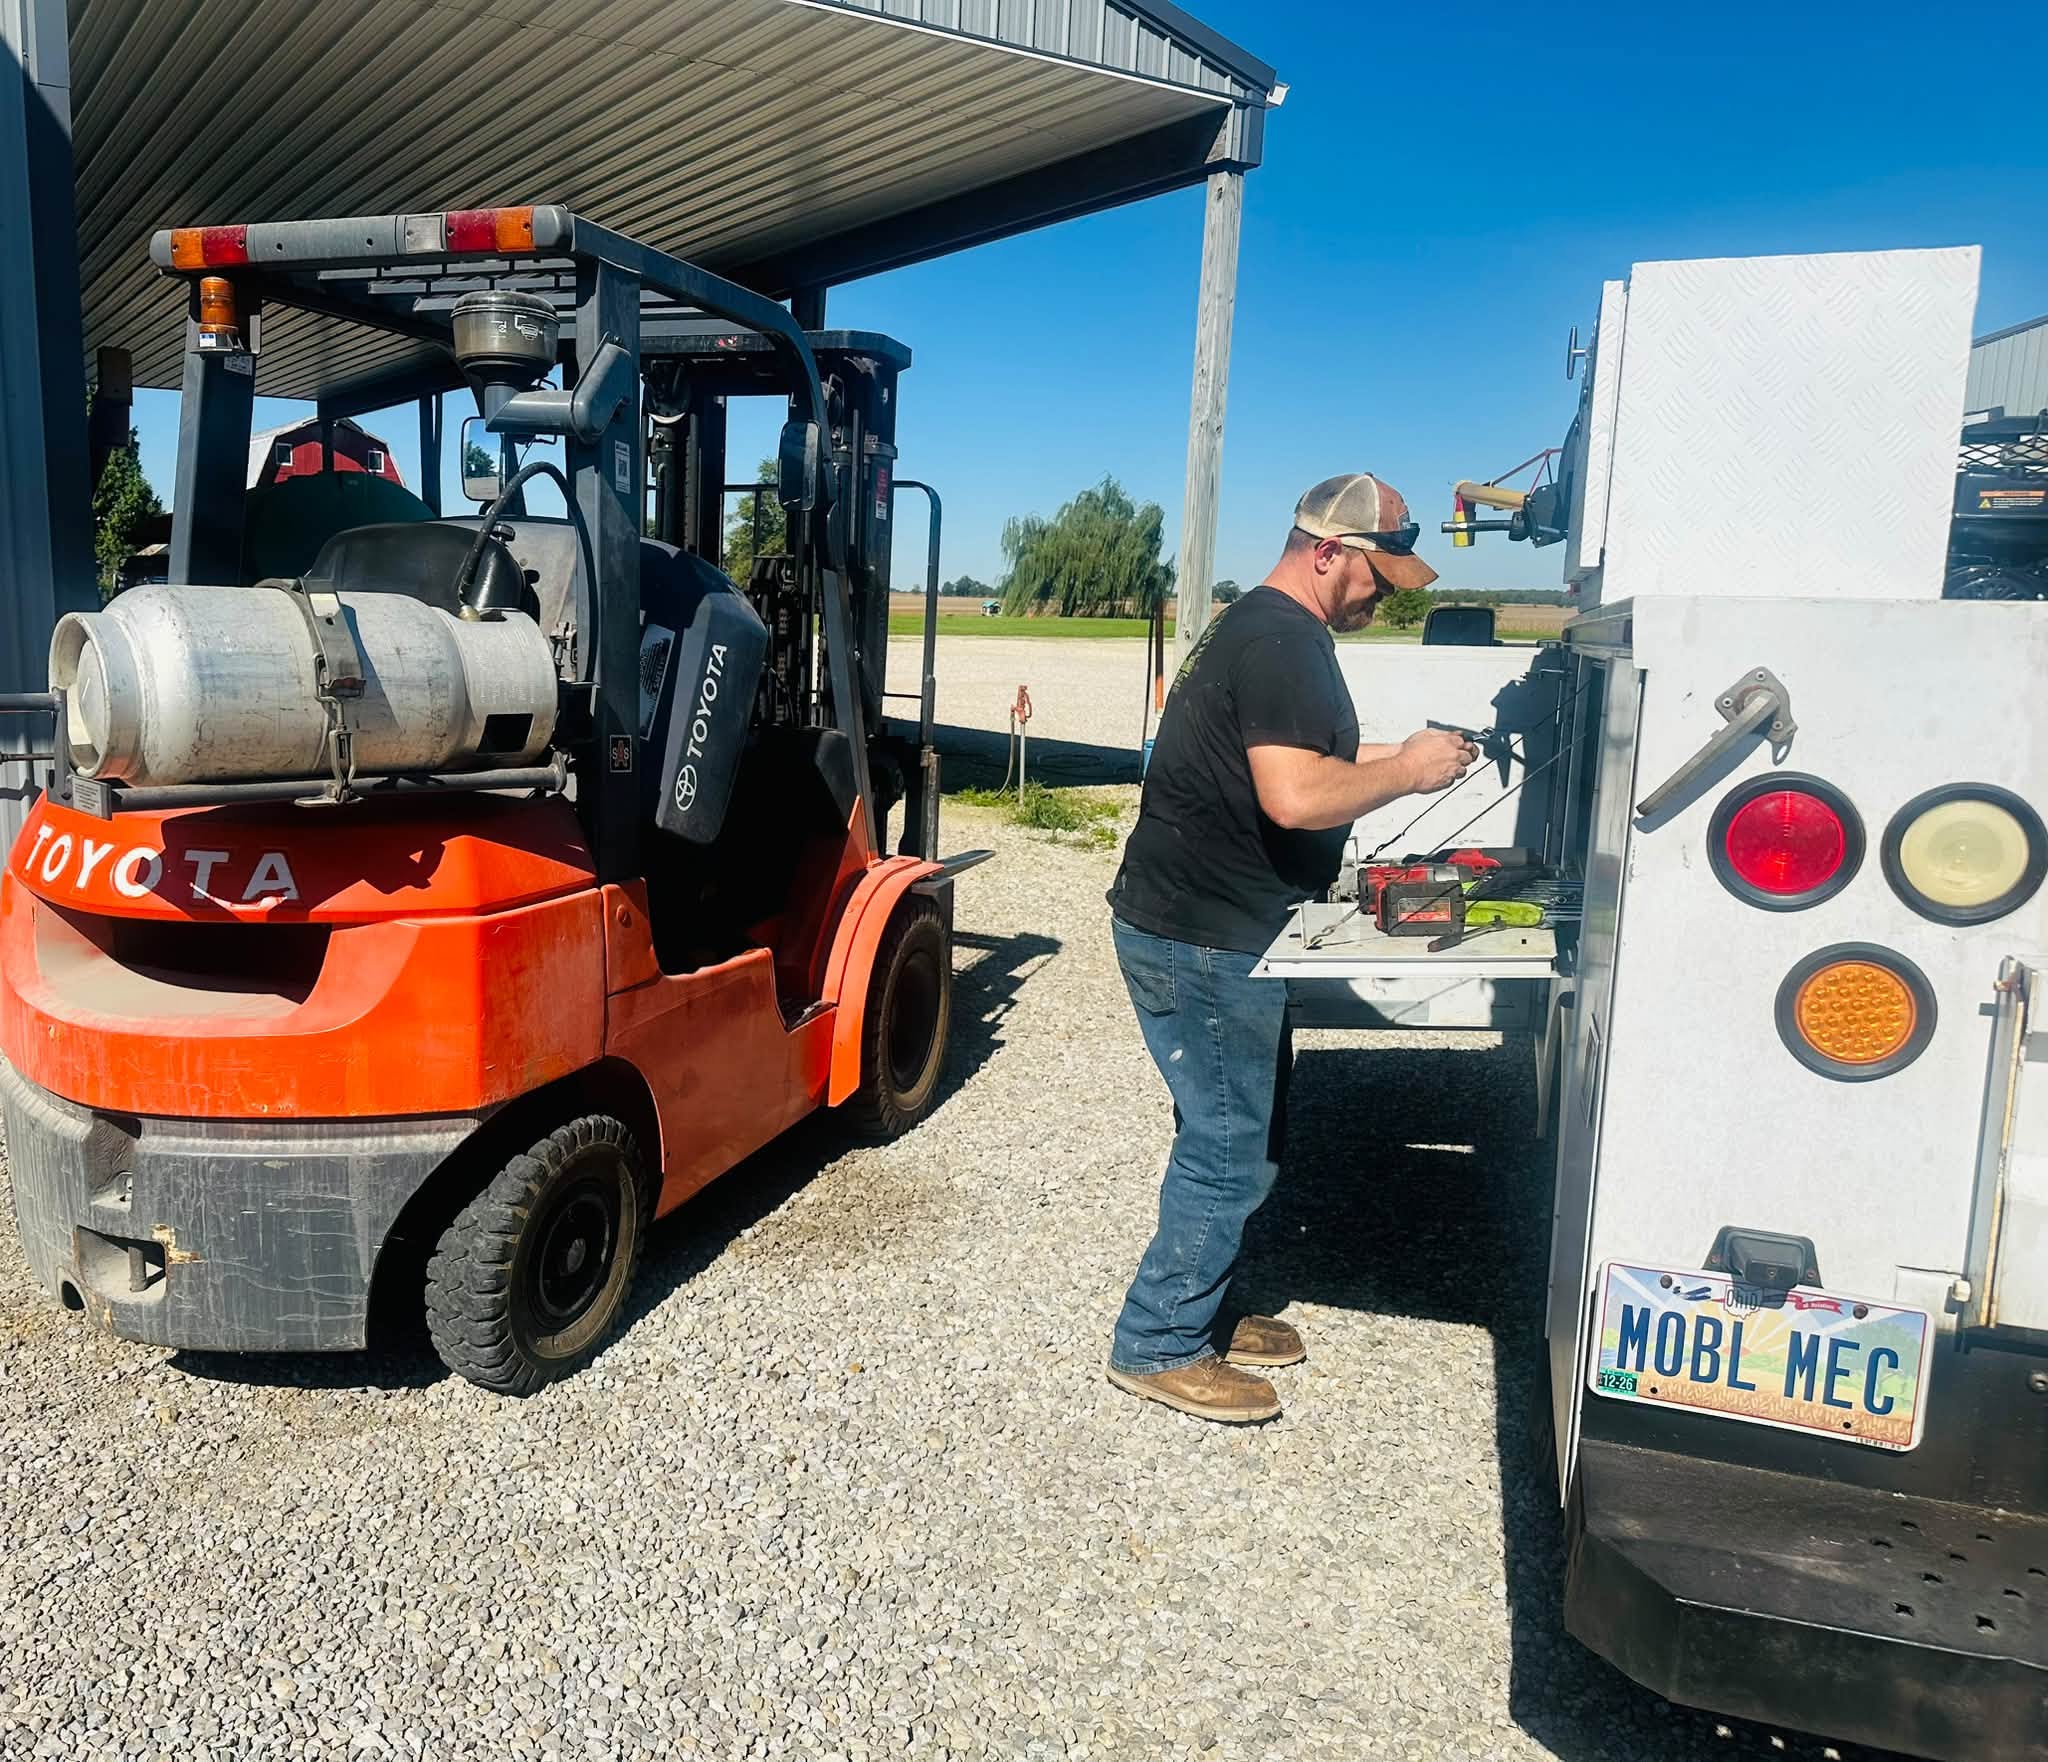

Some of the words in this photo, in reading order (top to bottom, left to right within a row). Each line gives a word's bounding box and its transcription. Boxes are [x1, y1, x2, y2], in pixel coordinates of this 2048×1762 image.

[686, 643, 728, 759] TOYOTA
[25, 823, 299, 900] TOYOTA
[1602, 1374, 1634, 1391] 12-26
[1616, 1303, 1756, 1392] MOBL
[1783, 1330, 1899, 1416] MEC
